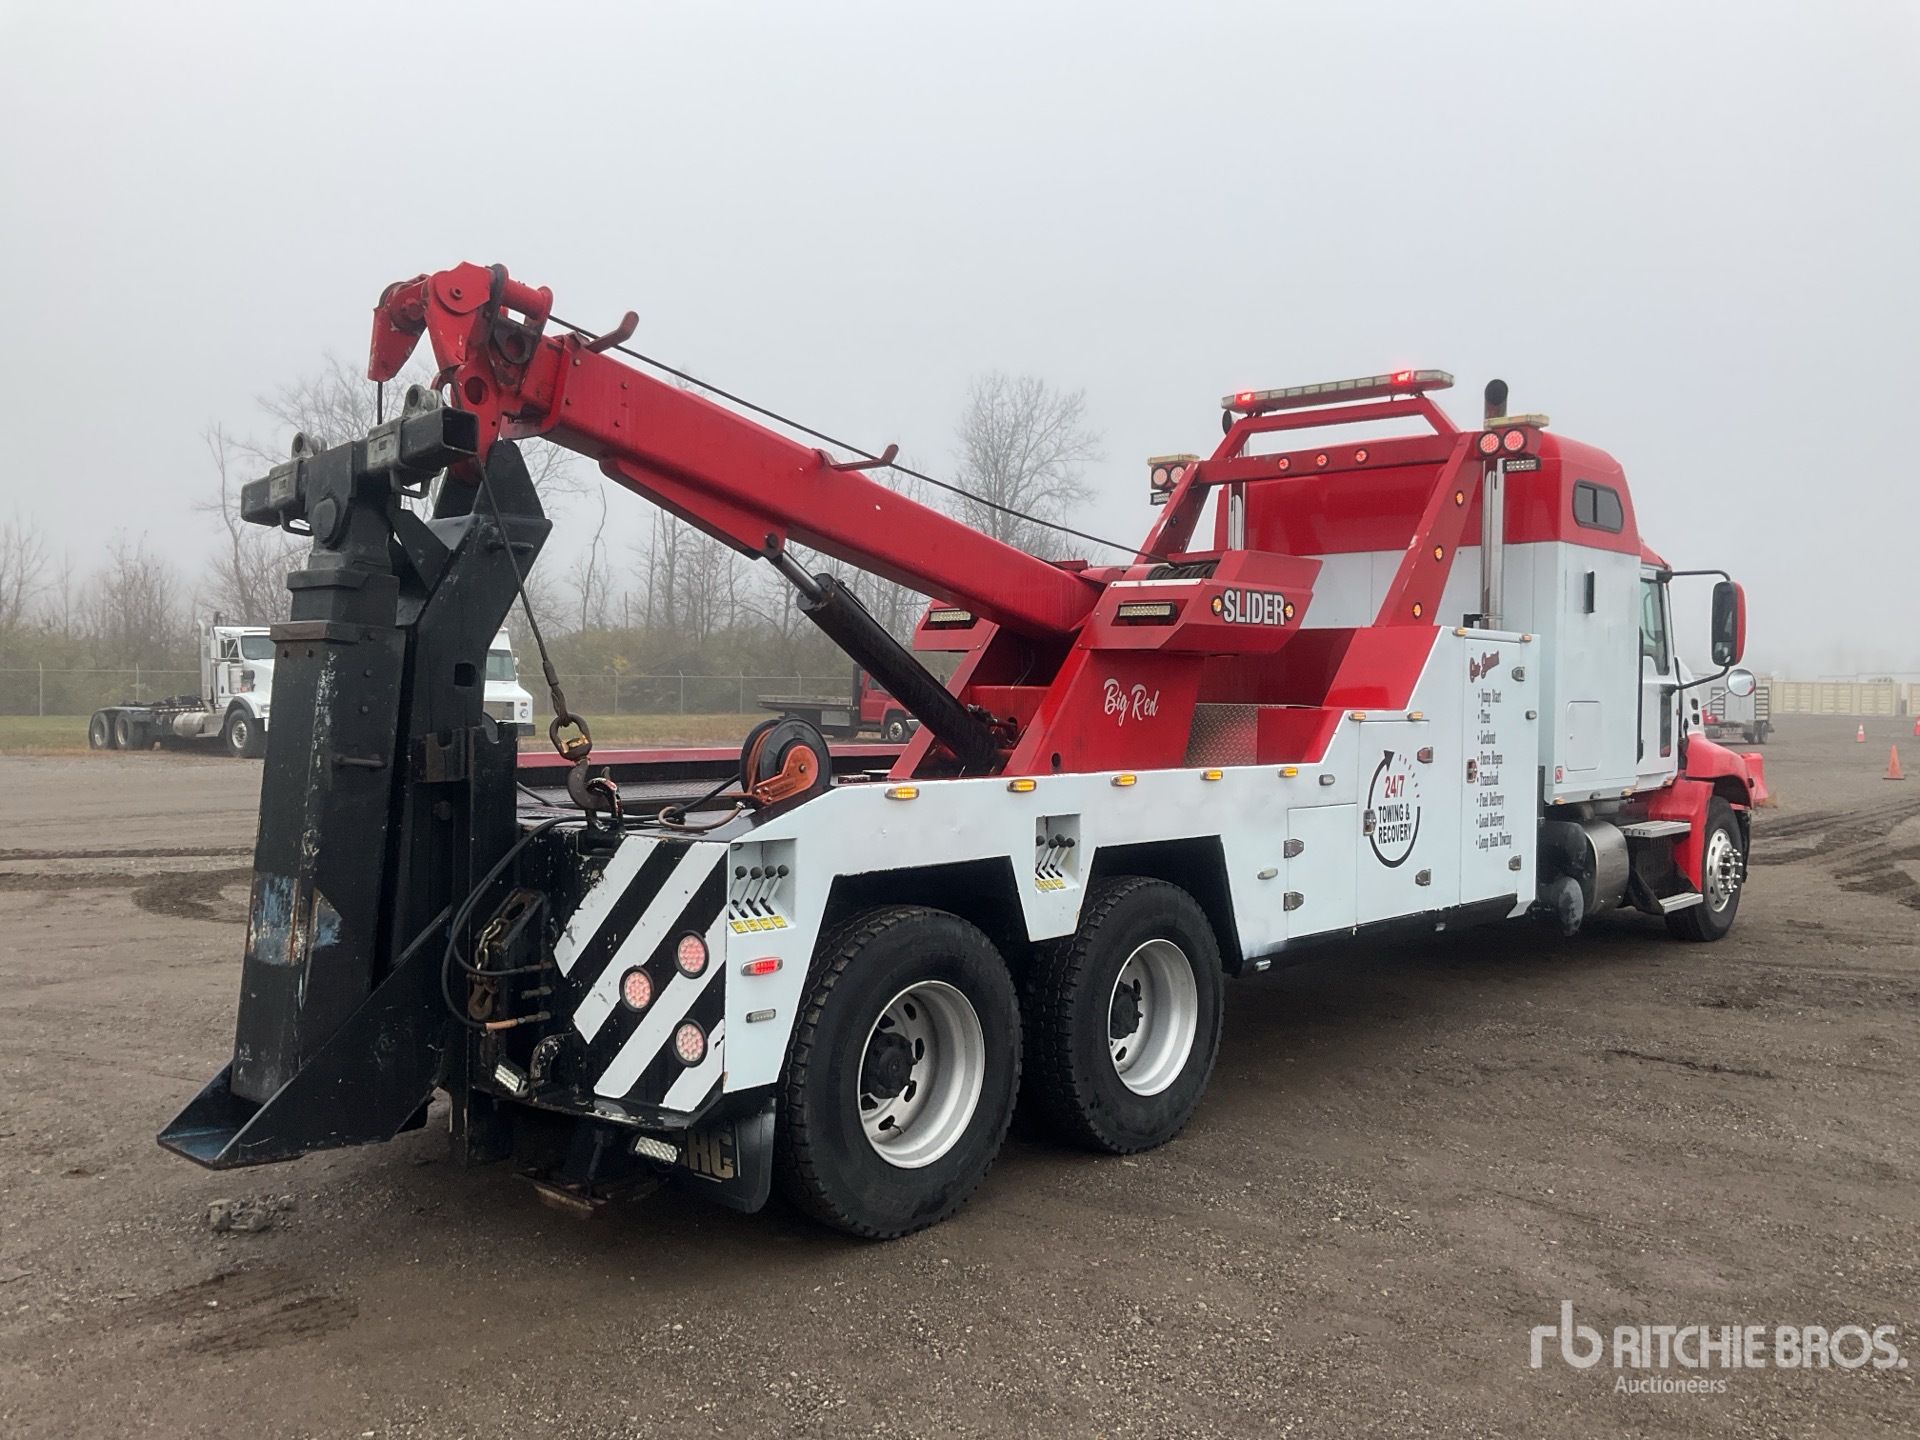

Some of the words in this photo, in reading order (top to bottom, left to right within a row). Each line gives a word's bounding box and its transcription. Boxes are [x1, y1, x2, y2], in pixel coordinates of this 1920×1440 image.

[1223, 589, 1285, 626] SLIDER
[1104, 678, 1130, 727] Big
[1131, 684, 1160, 721] Red
[1384, 774, 1405, 799] 24/7
[1489, 791, 1505, 810] Delivery
[1378, 804, 1404, 824] TOWING
[1405, 802, 1411, 821] &
[1489, 811, 1505, 830] Delivery
[1378, 822, 1412, 845] RECOVERY
